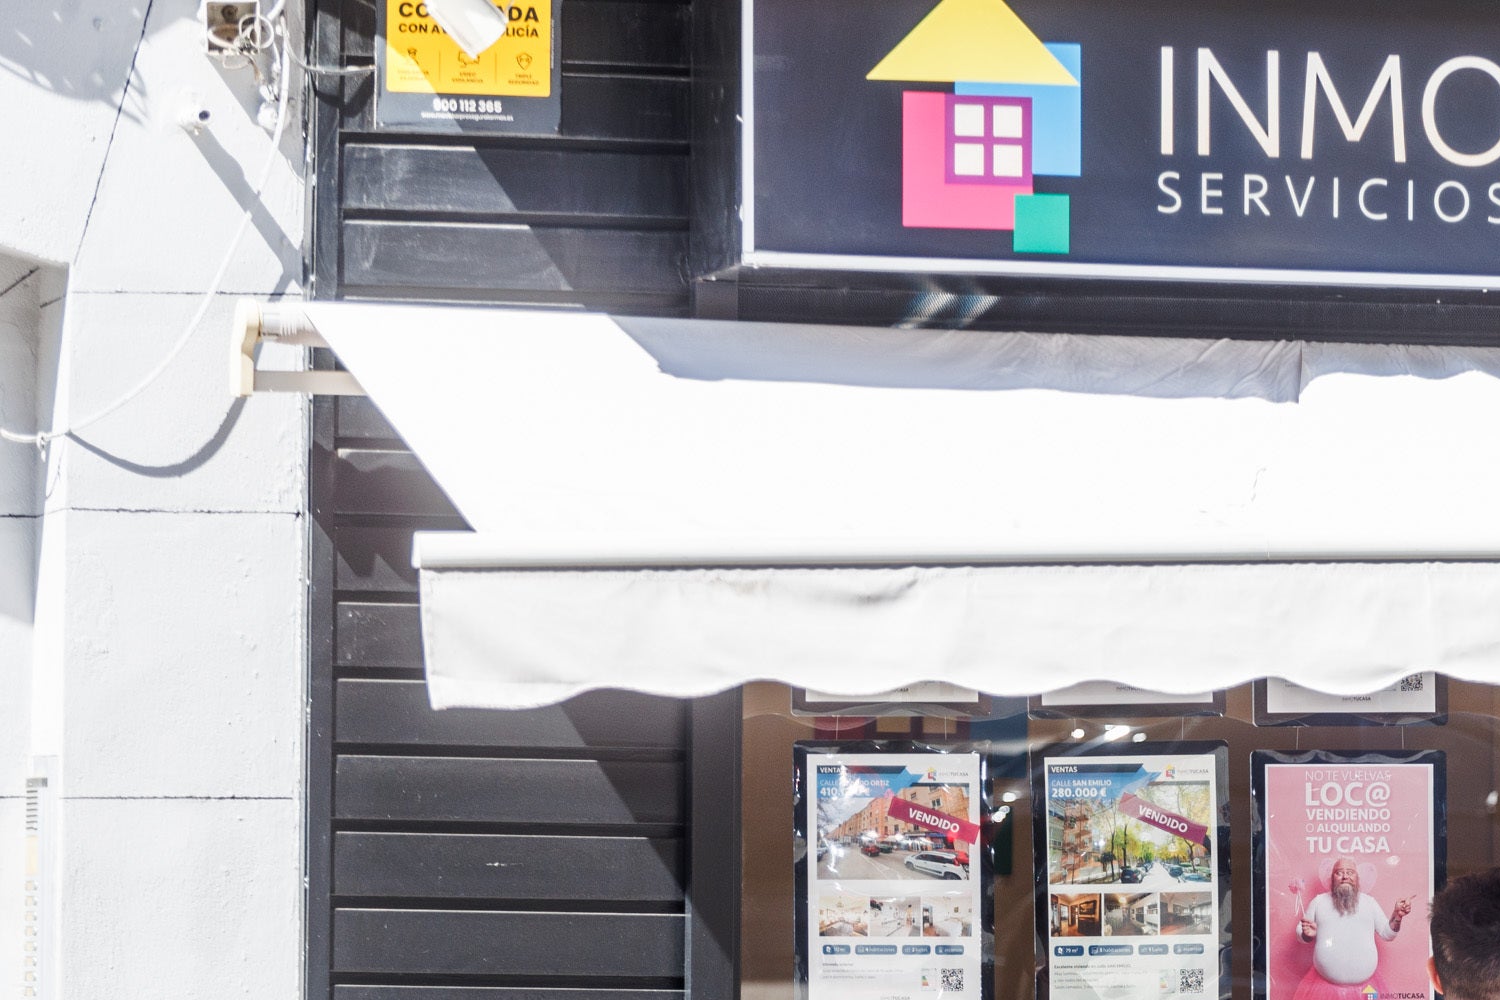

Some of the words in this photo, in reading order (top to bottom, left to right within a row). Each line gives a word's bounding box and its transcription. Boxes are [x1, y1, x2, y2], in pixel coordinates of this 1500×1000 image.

[398, 23, 428, 33] CON
[459, 99, 477, 112] 112
[1305, 770, 1324, 781] NO
[1326, 770, 1338, 781] TE
[1342, 770, 1391, 781] VUELVAS
[1051, 788, 1098, 798] 280.000
[1099, 788, 1107, 797] €
[1305, 781, 1391, 807] LOC@
[1139, 805, 1188, 833] VENDIDO
[1305, 808, 1391, 820] VENDIENDO
[909, 808, 960, 834] VENDIDO
[1305, 823, 1314, 833] O
[1317, 823, 1391, 834] ALQUILANDO
[1306, 836, 1332, 853] TU
[1336, 836, 1390, 854] CASA
